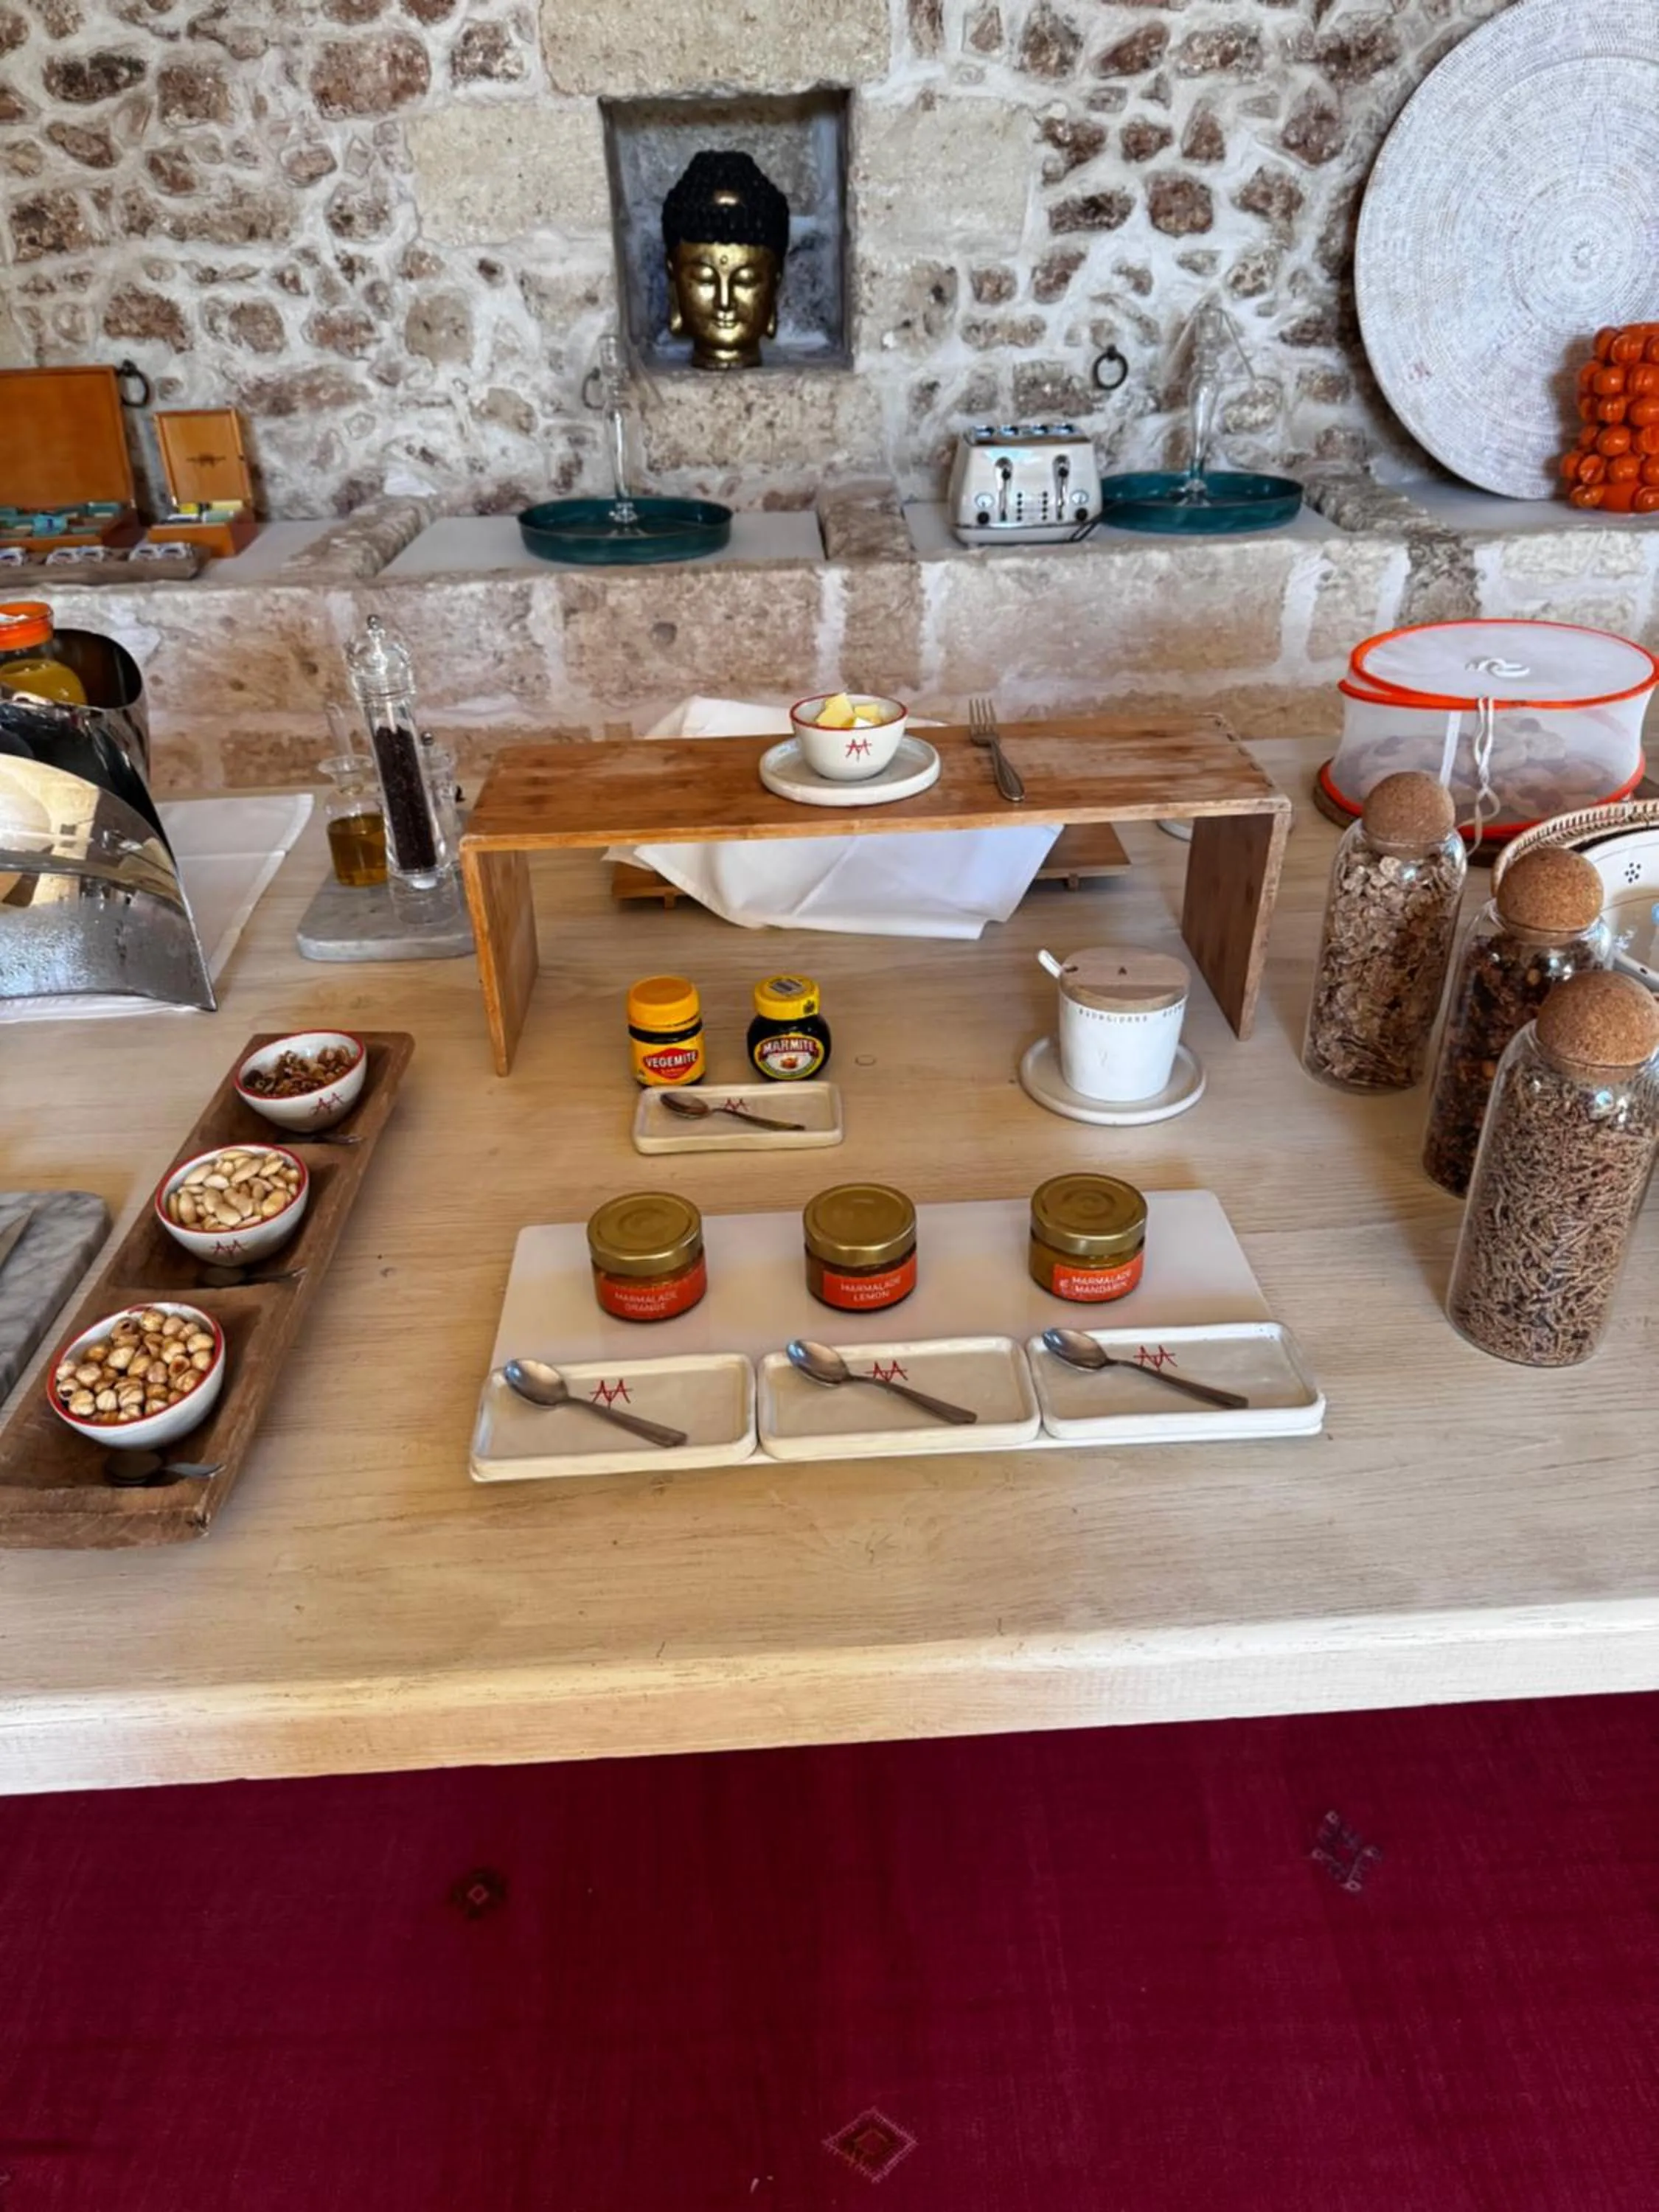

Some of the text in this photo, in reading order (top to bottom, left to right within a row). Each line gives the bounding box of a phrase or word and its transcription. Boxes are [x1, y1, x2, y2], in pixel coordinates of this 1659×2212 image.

[762, 1038, 815, 1054] MARMITE
[646, 1051, 696, 1068] VEGEMITE
[841, 1276, 901, 1291] MARMALADE
[1072, 1269, 1131, 1285] MARMALADE
[853, 1290, 890, 1302] LEMON
